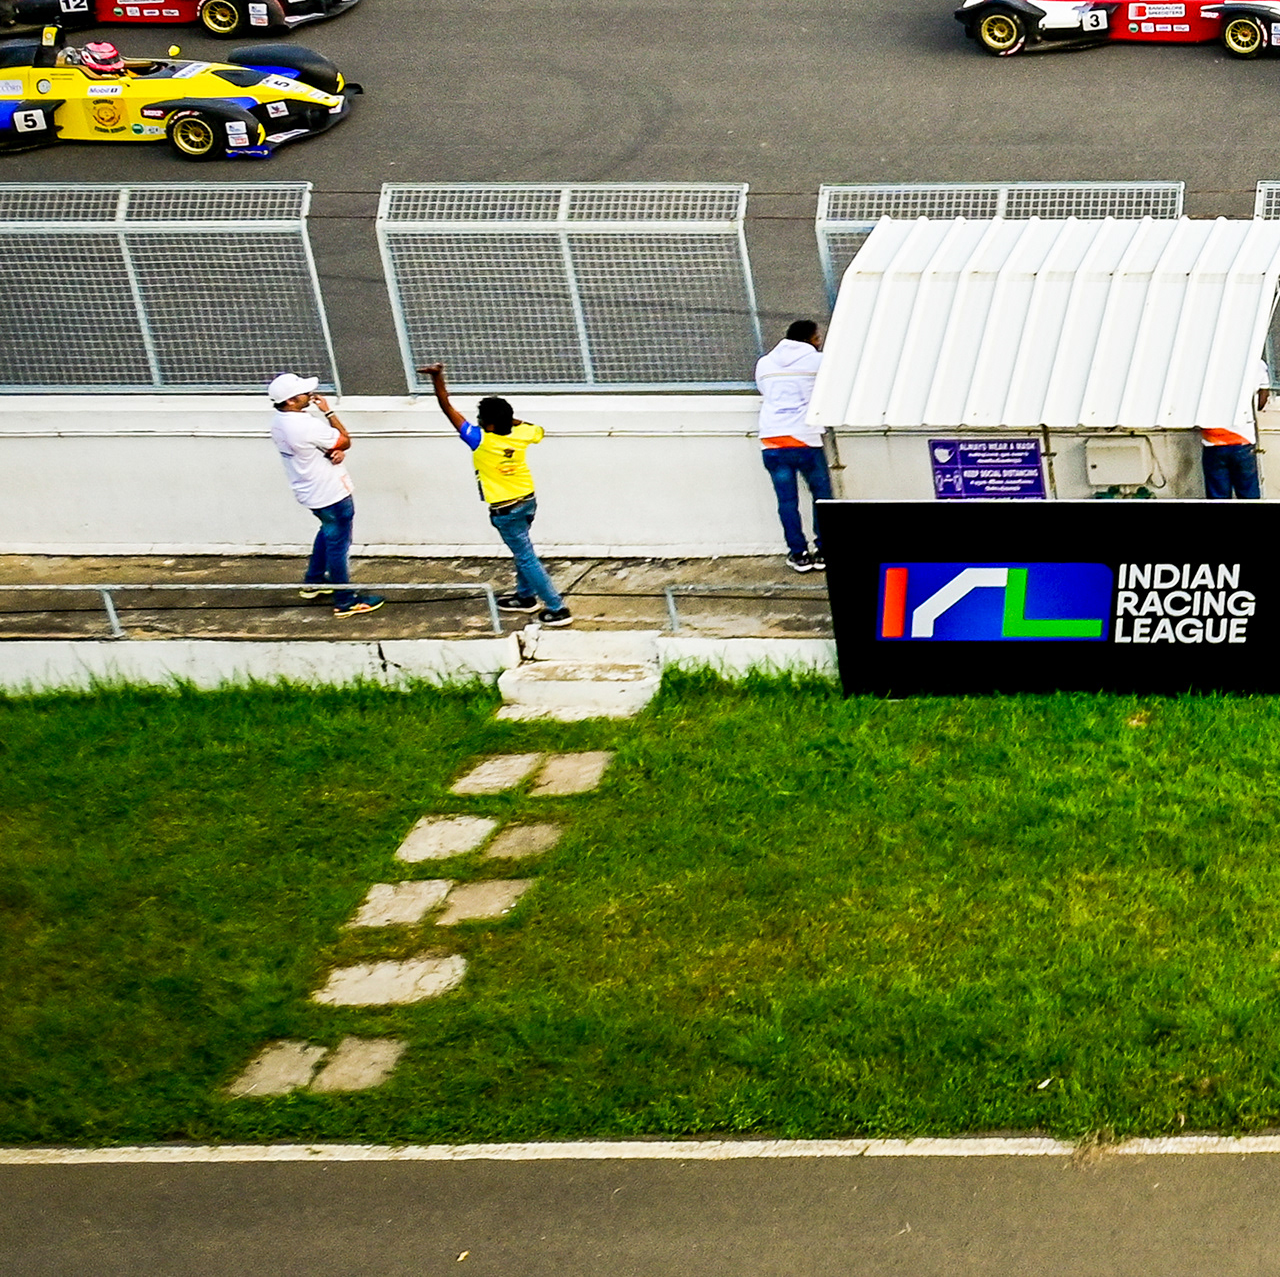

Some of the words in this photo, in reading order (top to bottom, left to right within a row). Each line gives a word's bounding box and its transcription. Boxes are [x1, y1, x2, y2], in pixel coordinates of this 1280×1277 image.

[1089, 13, 1100, 28] 3
[24, 113, 38, 129] 5
[1117, 564, 1241, 590] INDIAN
[1116, 590, 1257, 617] RACING
[1114, 617, 1248, 644] LEAGUE
